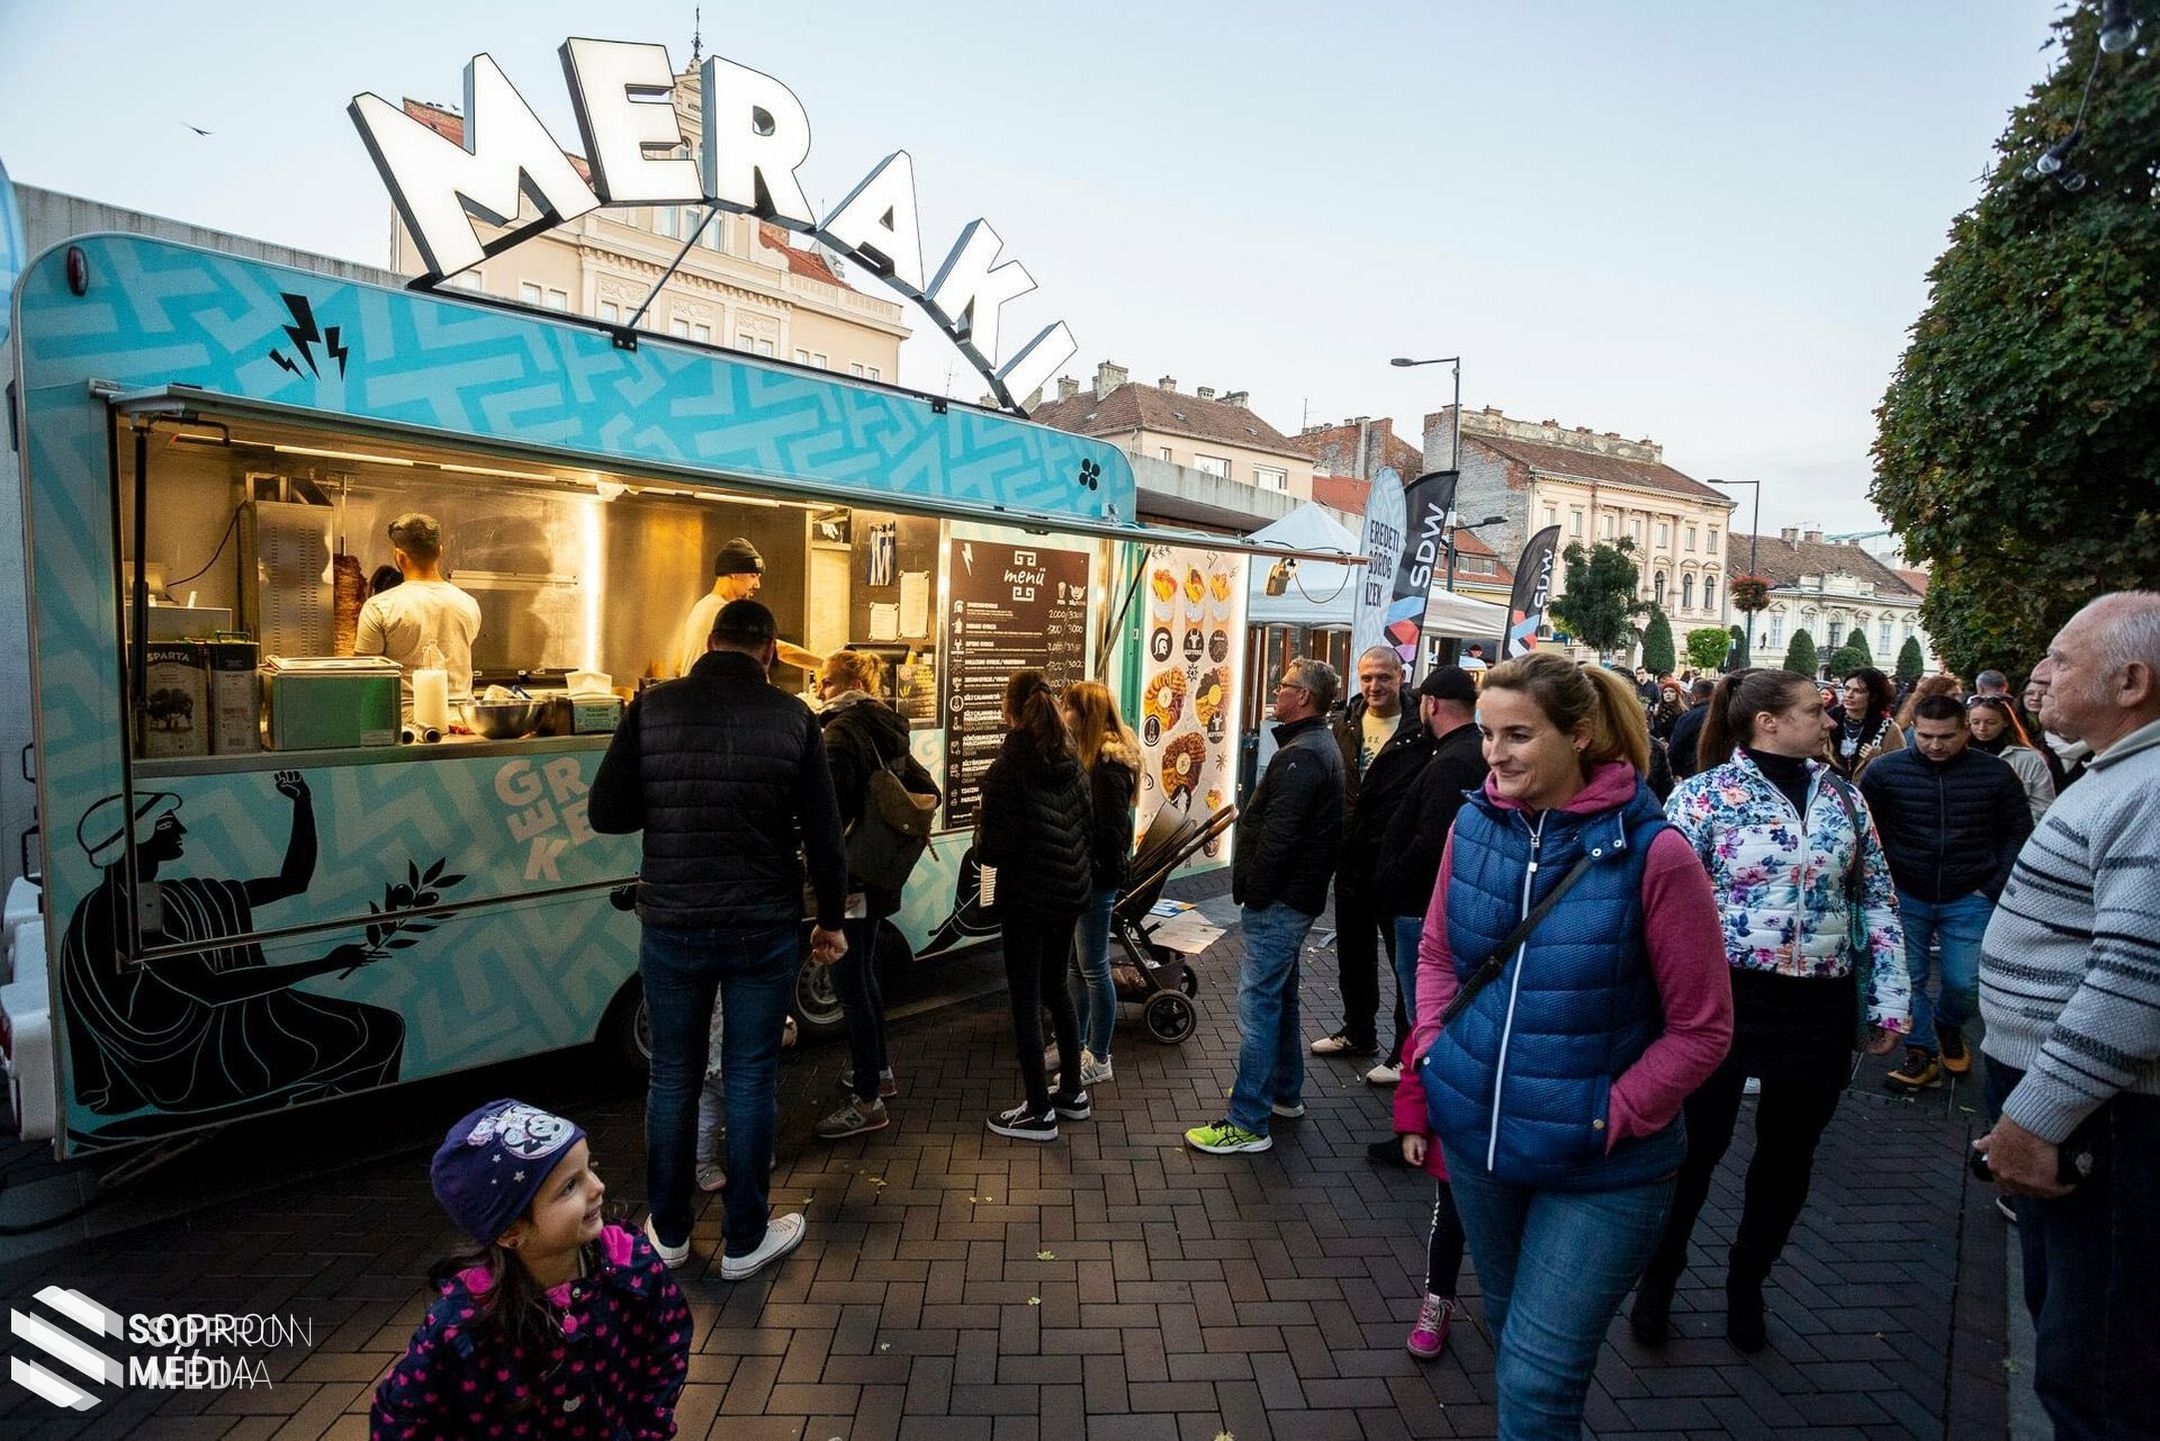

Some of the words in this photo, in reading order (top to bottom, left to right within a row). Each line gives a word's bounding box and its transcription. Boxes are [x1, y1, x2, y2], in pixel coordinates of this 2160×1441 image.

[347, 37, 1078, 412] MERAKI
[1369, 520, 1400, 553] EREDETI
[1410, 502, 1445, 589] SDW
[1003, 567, 1046, 587] menü
[1534, 549, 1553, 609] SDW
[147, 651, 190, 662] SPARTA
